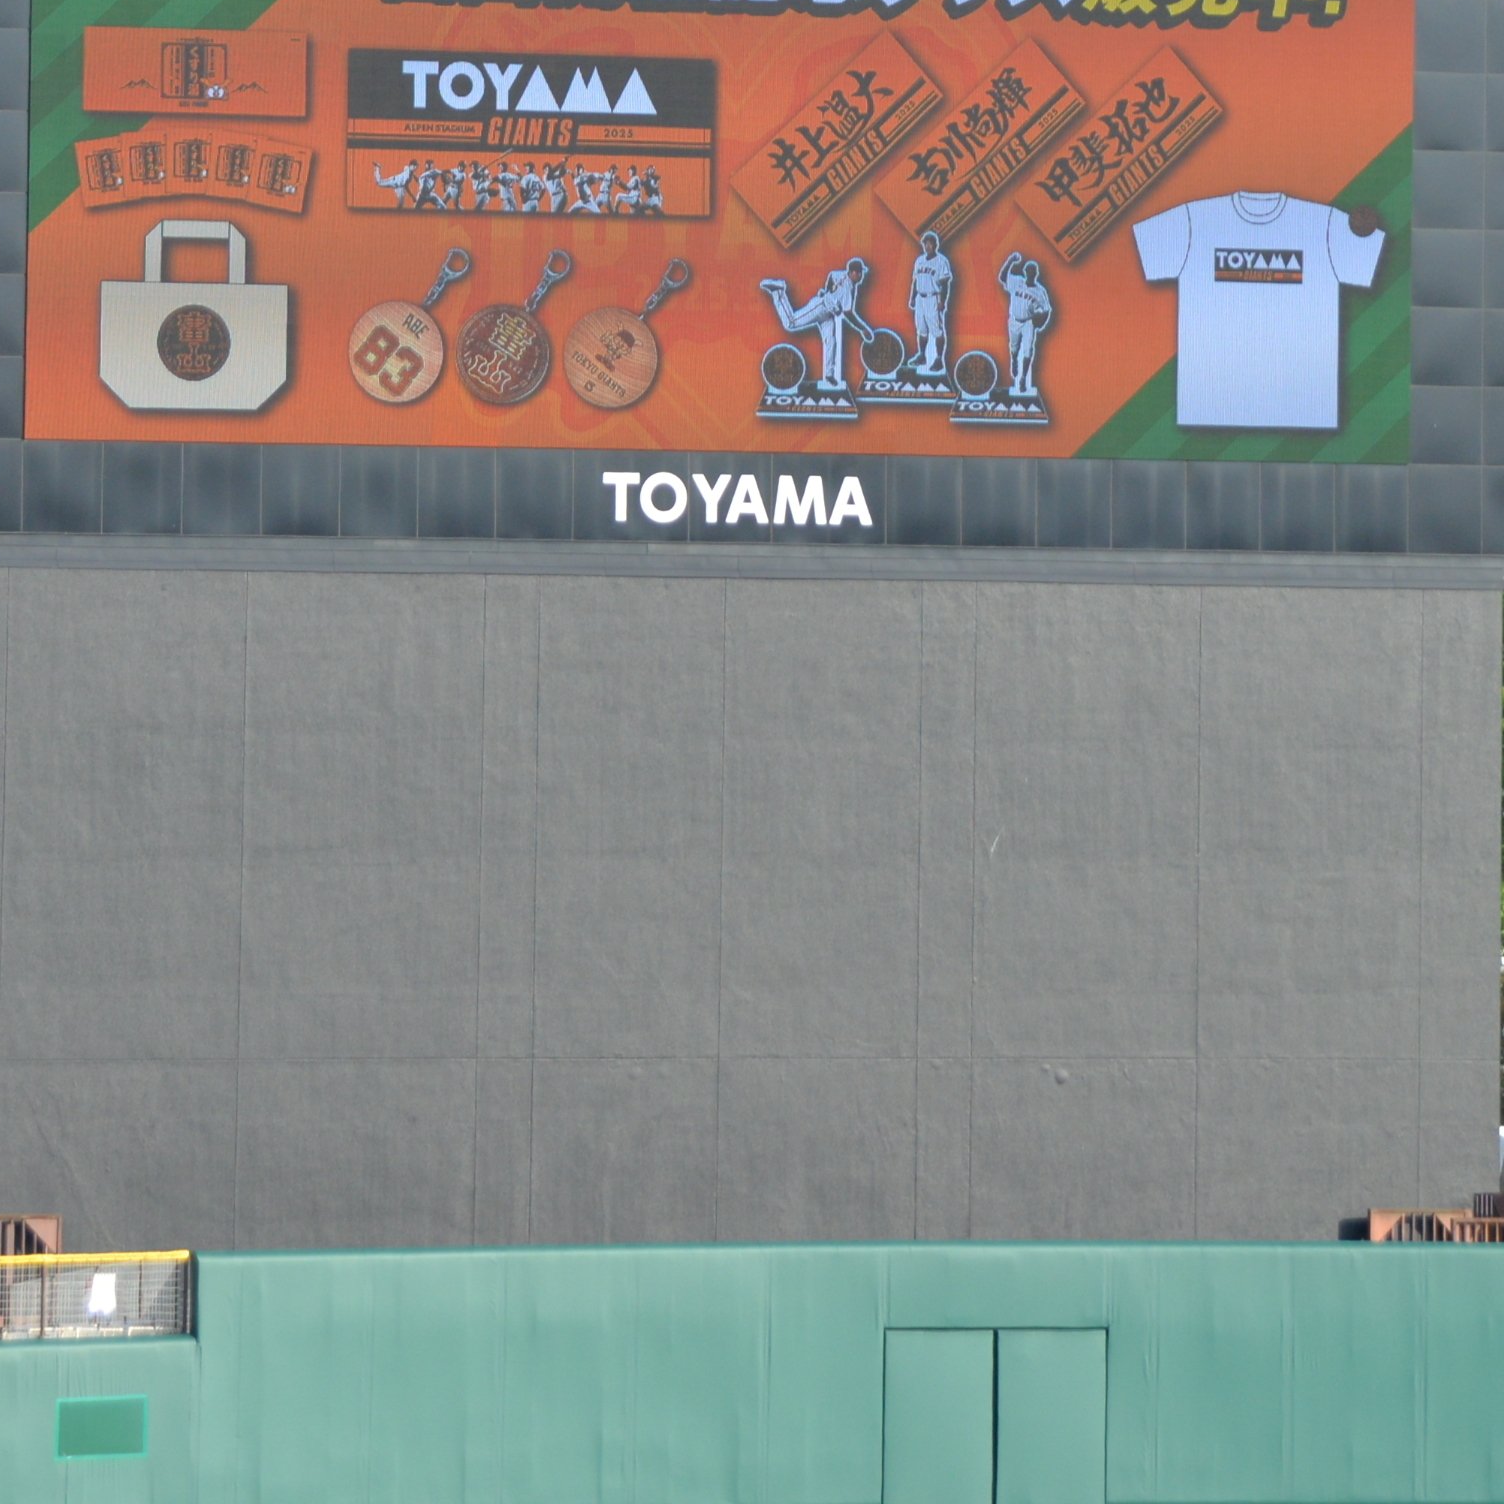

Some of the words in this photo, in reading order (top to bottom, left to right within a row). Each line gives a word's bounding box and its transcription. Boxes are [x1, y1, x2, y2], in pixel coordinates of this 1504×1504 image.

[402, 60, 658, 115] TOYAMA
[404, 123, 434, 132] ALPEN
[436, 124, 476, 134] STADIUM
[487, 116, 573, 147] GIANTS
[604, 128, 633, 139] 2025
[826, 129, 885, 195] GIANTS
[1109, 144, 1165, 206] GIANTS
[932, 201, 964, 232] OYAMA
[970, 137, 1027, 200] GIANTS
[1217, 251, 1300, 270] TOYAMA
[402, 313, 429, 339] ABE
[353, 324, 425, 397] 83
[864, 381, 950, 392] TOYAMA
[764, 396, 852, 407] TOYAMA
[957, 401, 1044, 413] TOYAMA
[602, 472, 873, 525] TOYAMA
